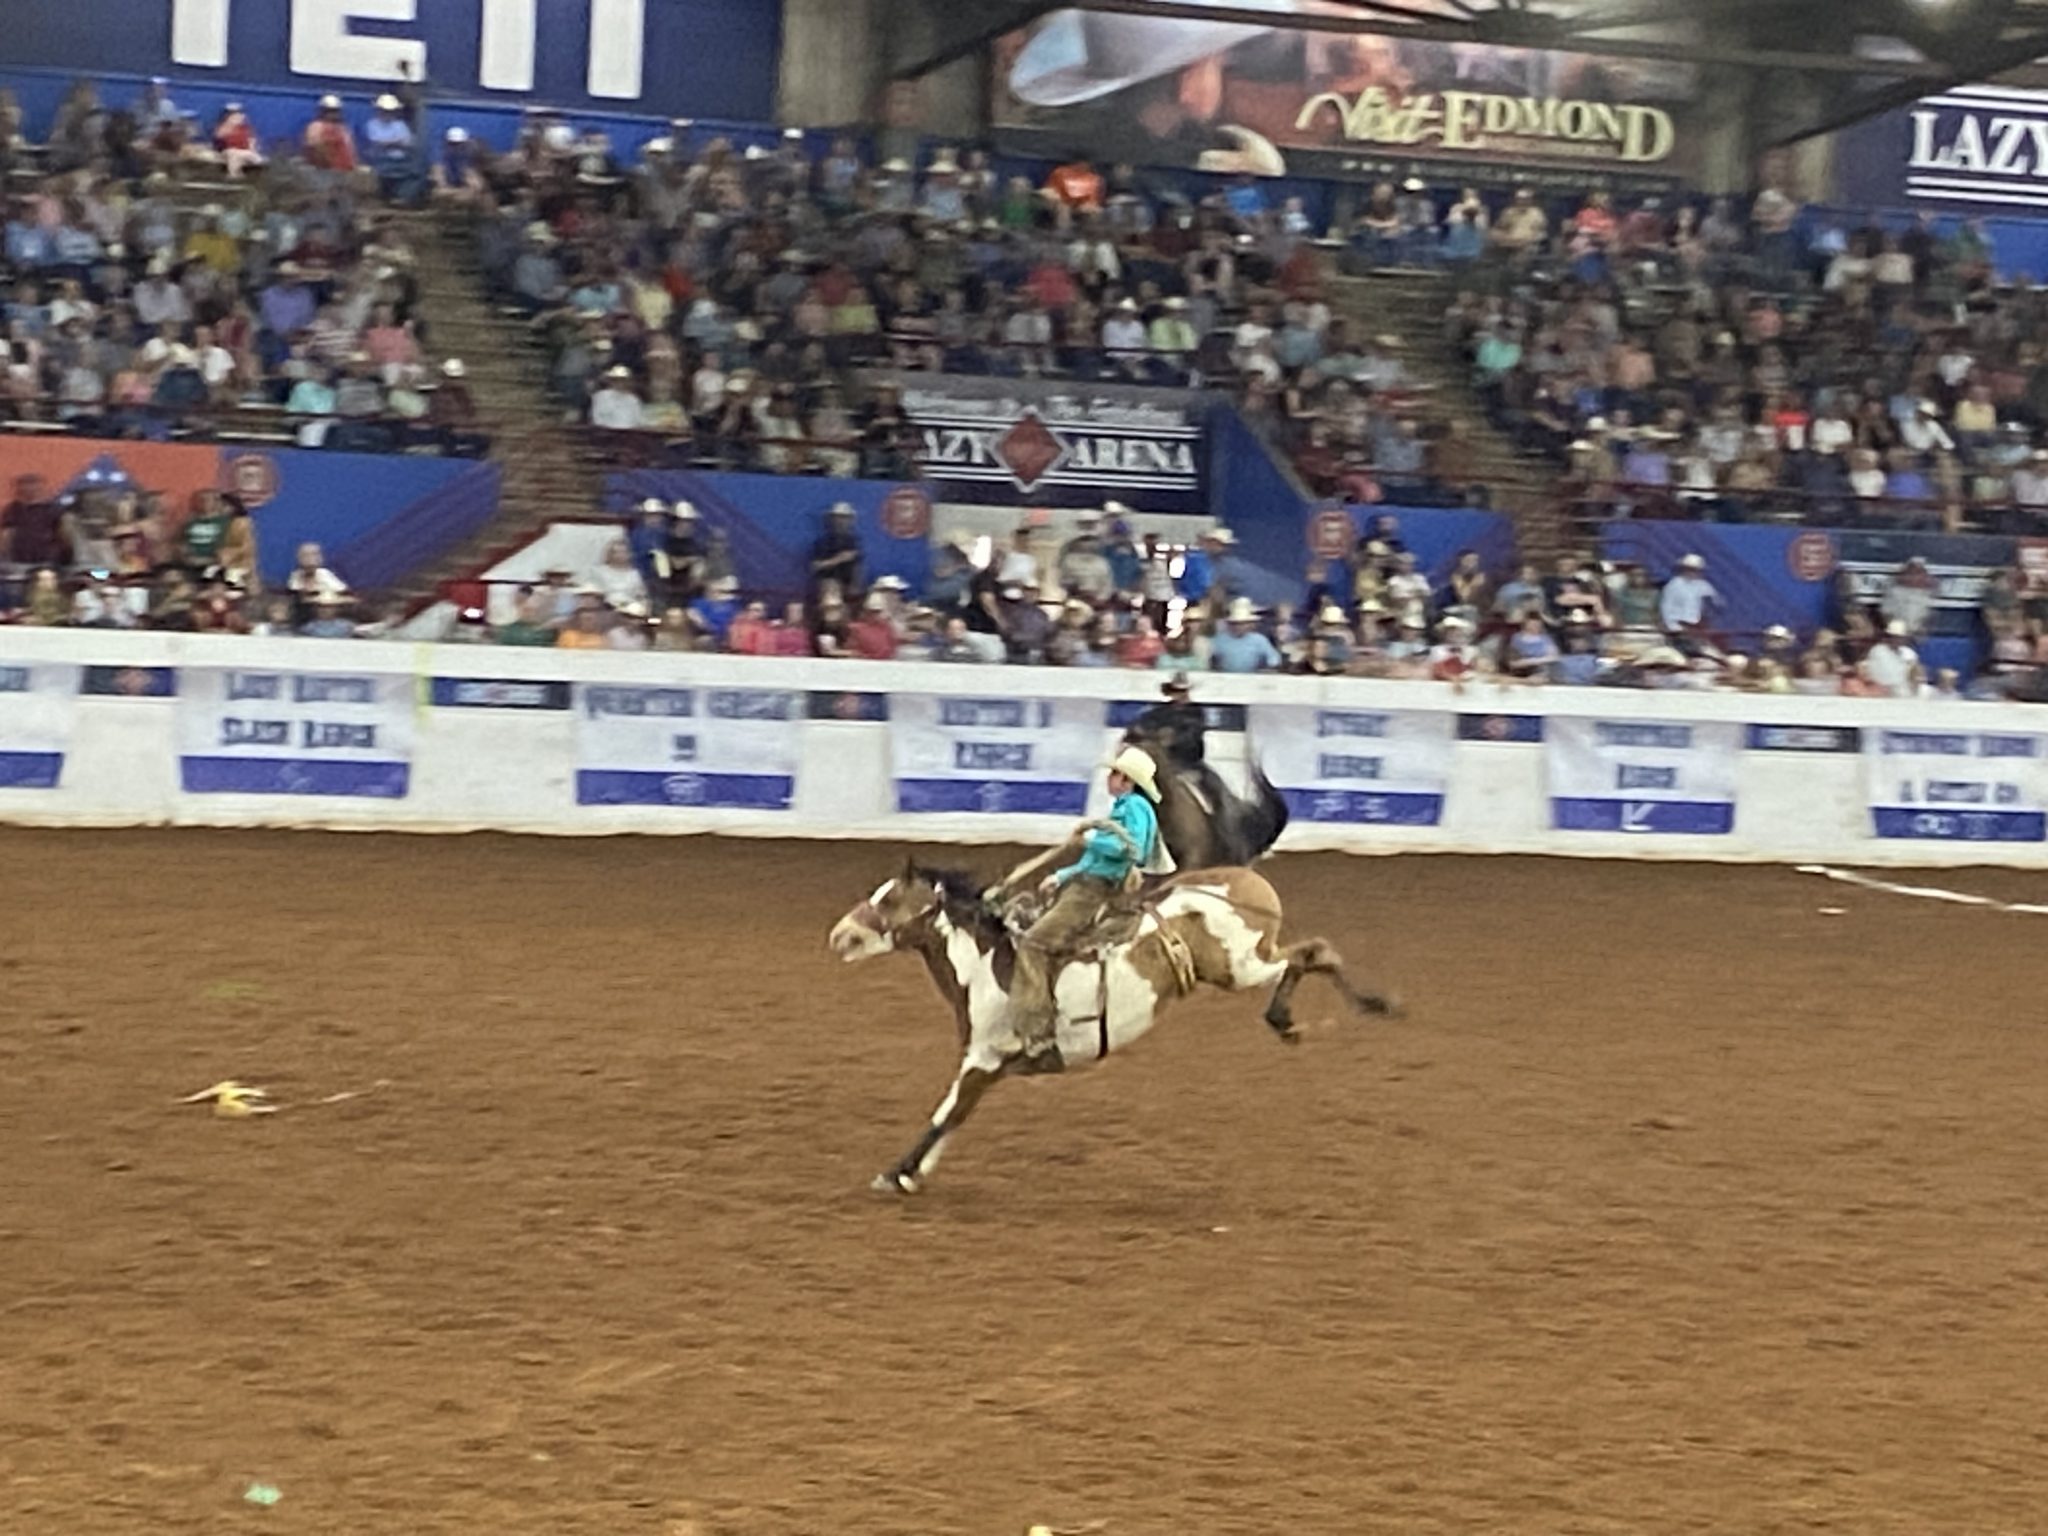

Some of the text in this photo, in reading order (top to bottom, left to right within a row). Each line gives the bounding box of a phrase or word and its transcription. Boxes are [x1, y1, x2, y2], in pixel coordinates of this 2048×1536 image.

[1298, 86, 1674, 162] Visit EDMOND
[1067, 437, 1196, 474] ARENA
